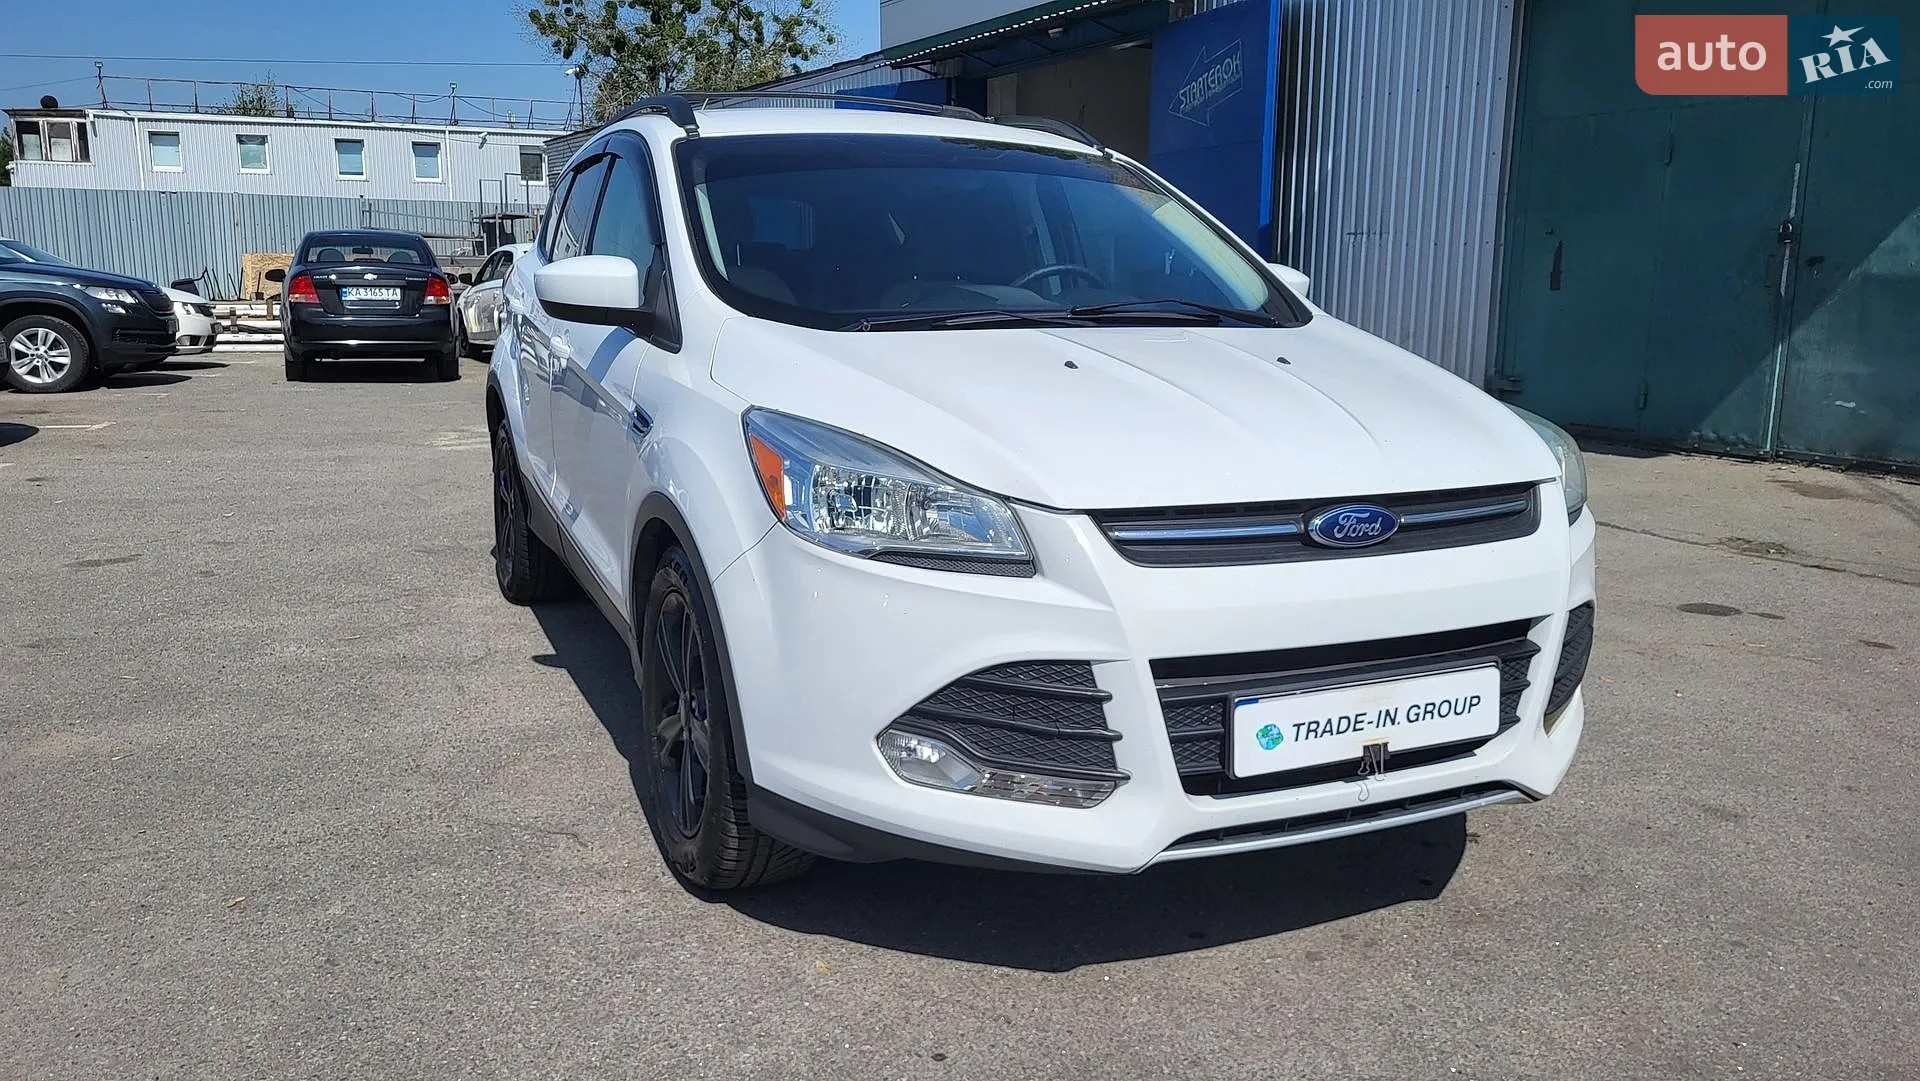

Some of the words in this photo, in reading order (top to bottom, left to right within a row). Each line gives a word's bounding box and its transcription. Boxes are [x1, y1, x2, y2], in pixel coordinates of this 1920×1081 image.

[347, 287, 362, 297] KA
[363, 287, 384, 297] 3165
[385, 287, 399, 297] TA
[1333, 512, 1382, 538] Ford
[1406, 695, 1482, 723] GROUP
